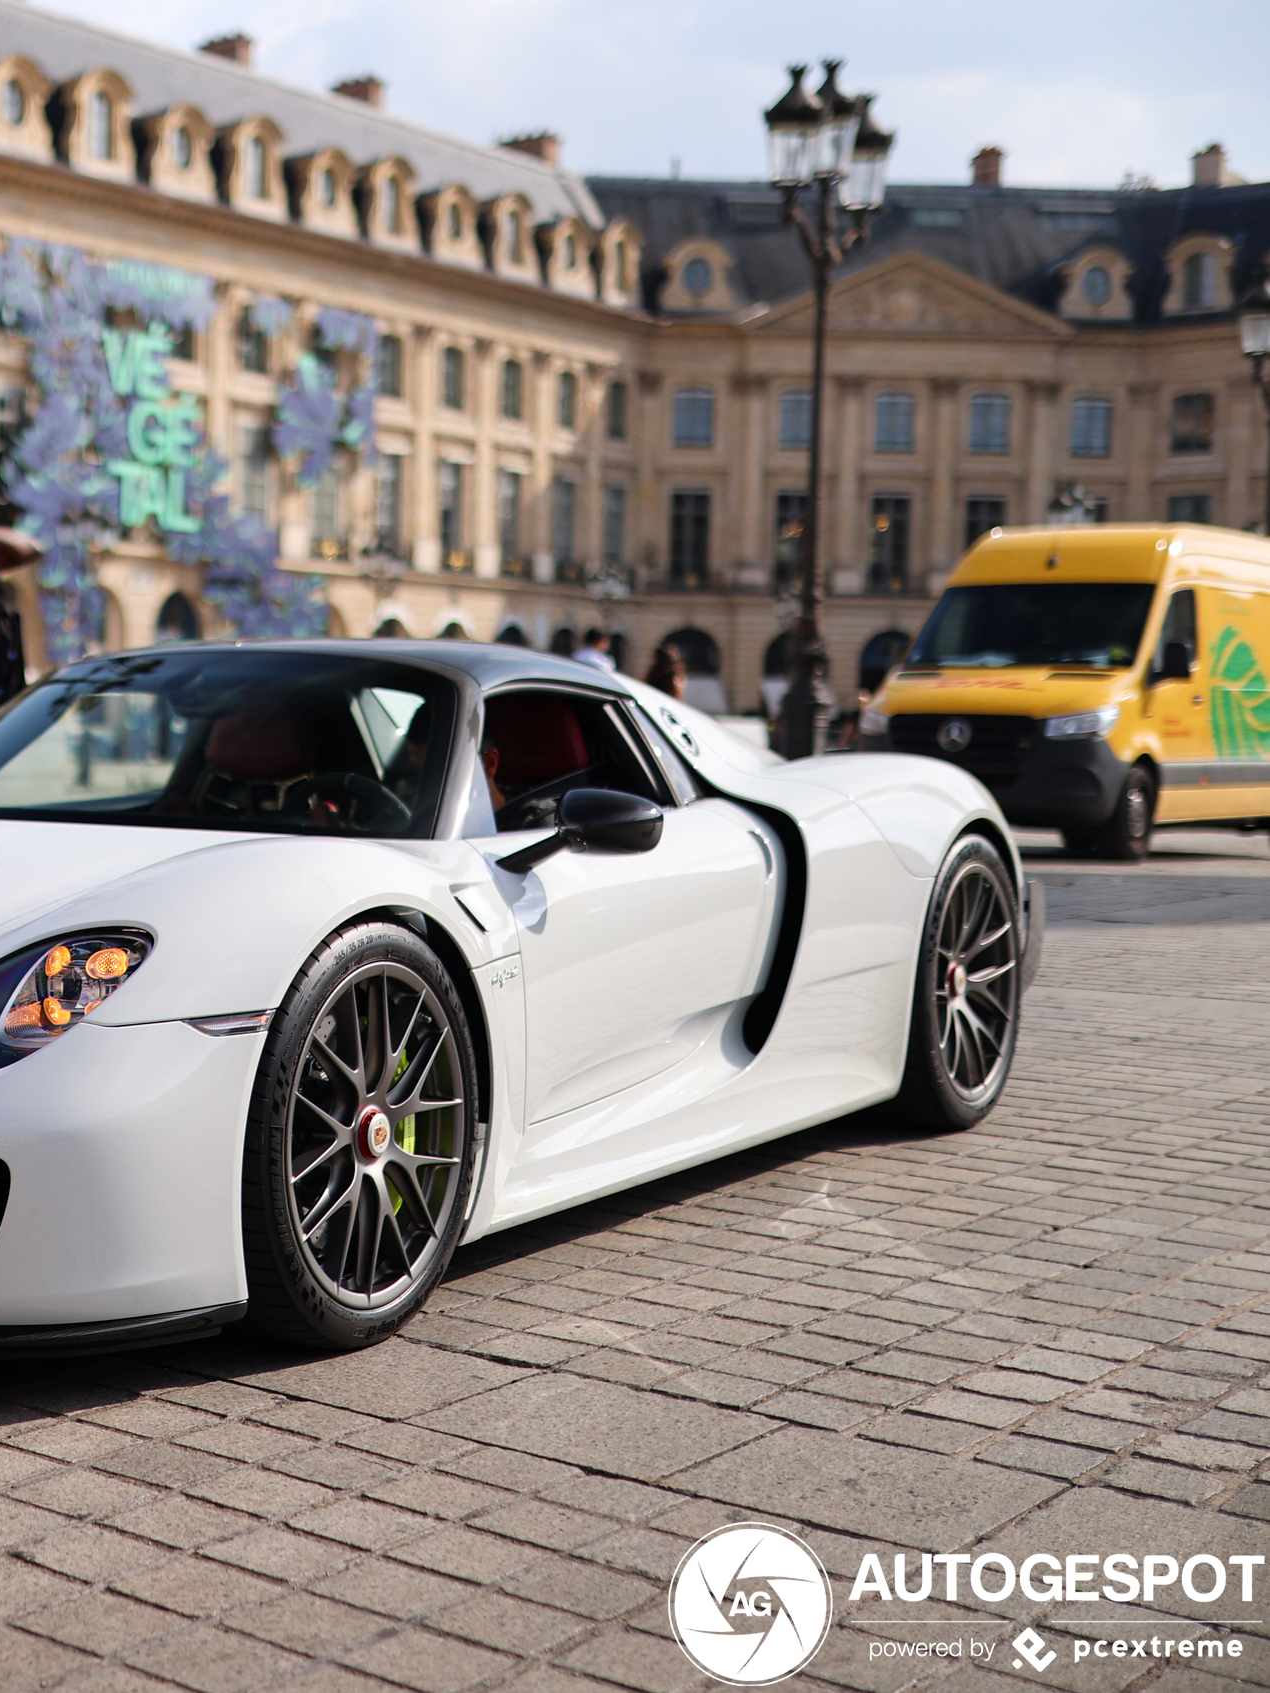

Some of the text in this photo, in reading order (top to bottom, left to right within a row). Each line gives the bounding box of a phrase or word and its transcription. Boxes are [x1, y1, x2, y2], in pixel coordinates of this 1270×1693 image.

[106, 458, 202, 533] TAL
[364, 933, 373, 945] 20
[271, 1127, 294, 1256] MICHELIN
[366, 1325, 376, 1339] 2
[376, 1316, 395, 1335] Cup
